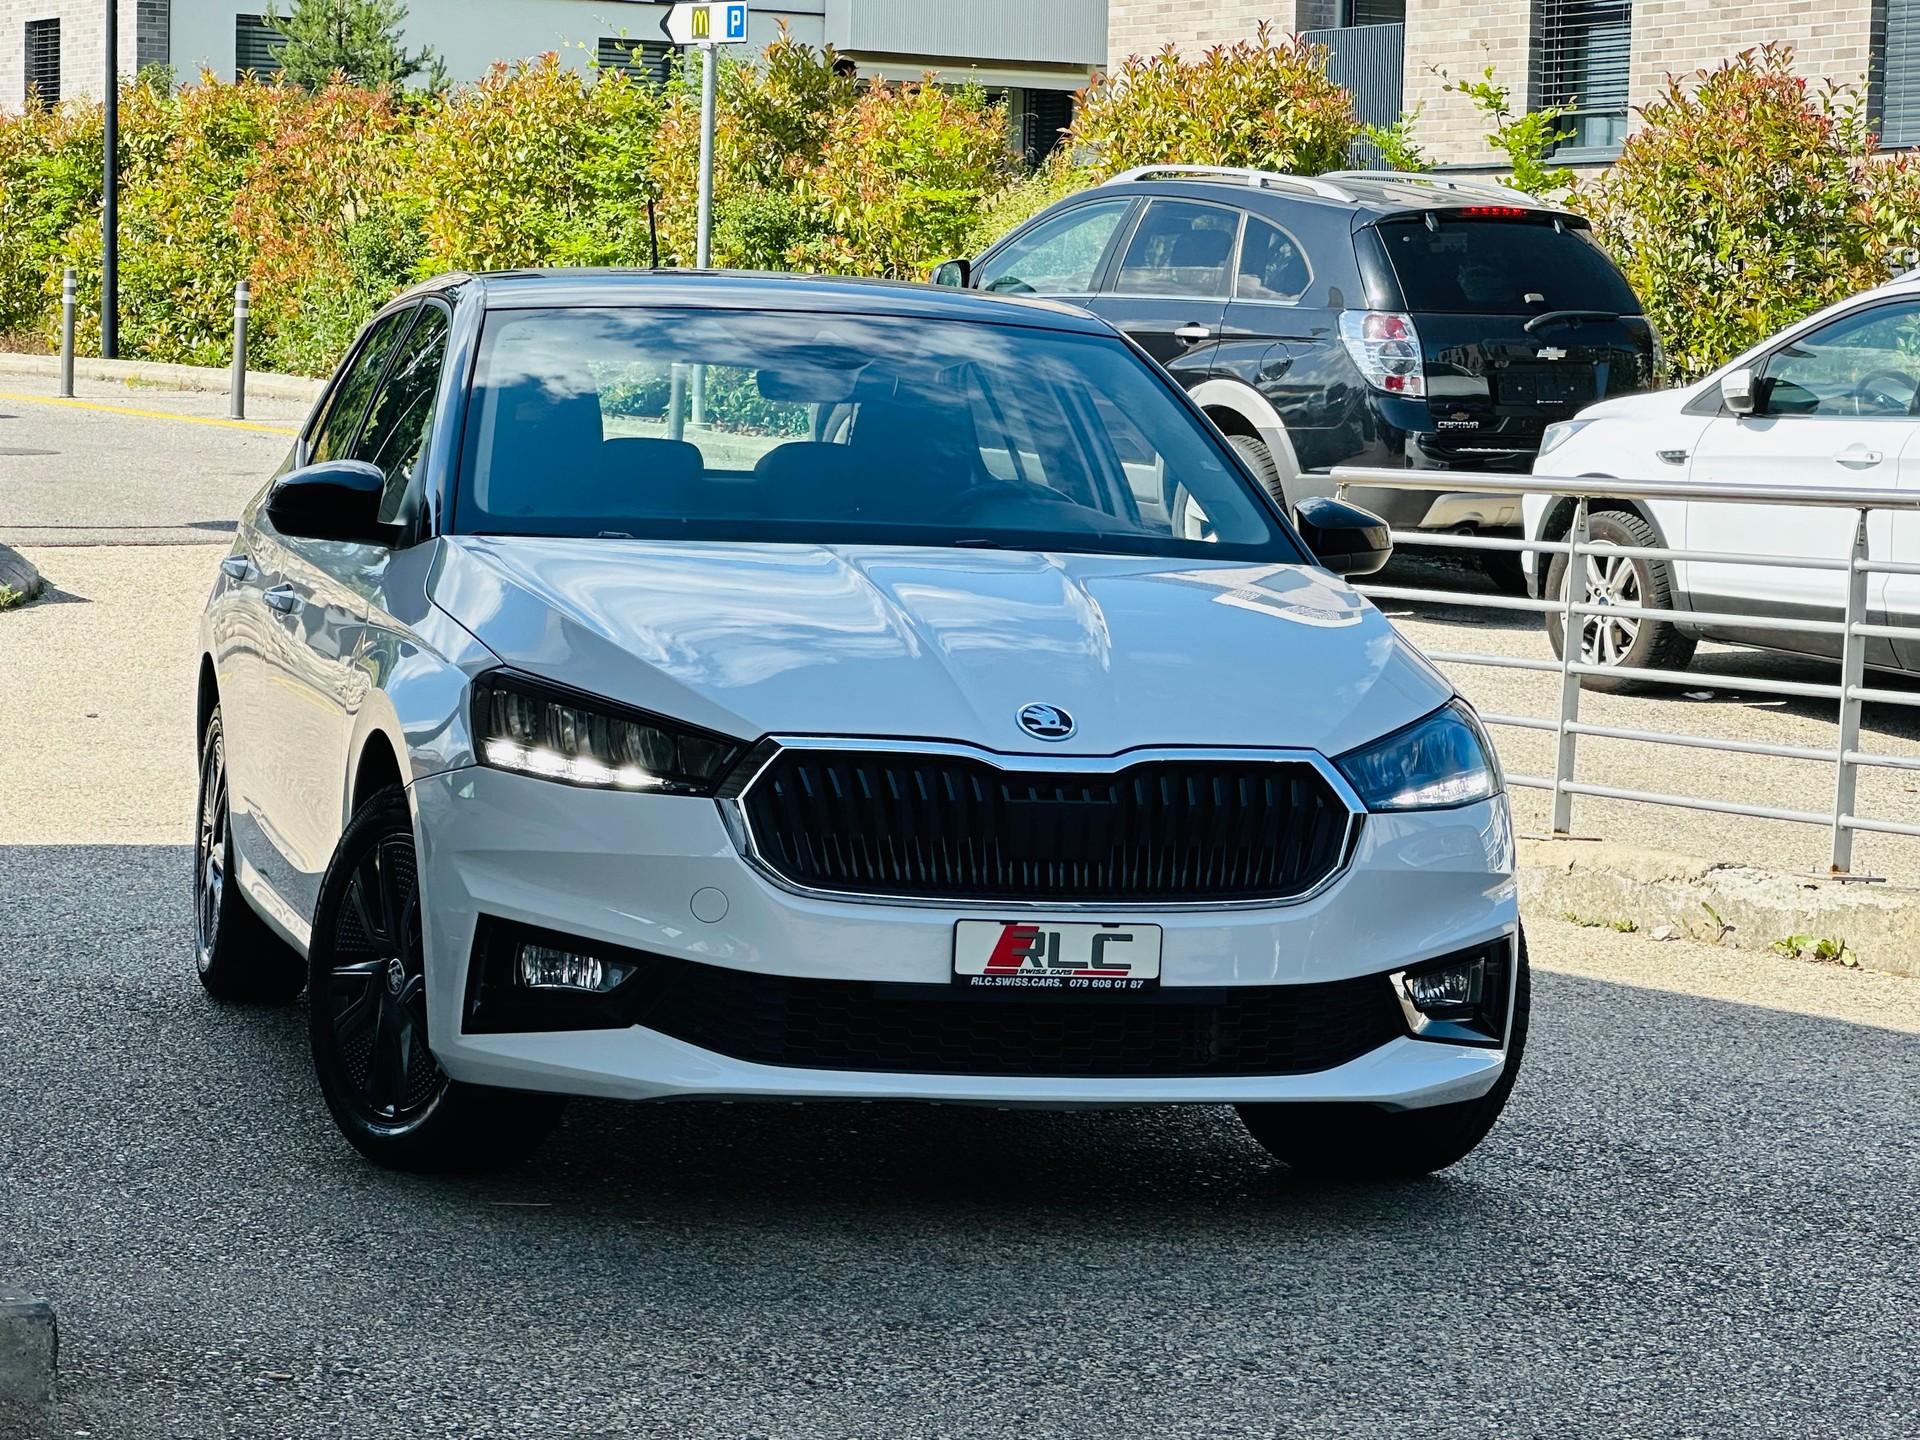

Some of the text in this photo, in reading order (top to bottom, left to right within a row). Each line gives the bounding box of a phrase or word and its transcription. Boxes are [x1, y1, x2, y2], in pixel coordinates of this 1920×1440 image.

[731, 10, 741, 35] P
[1437, 421, 1479, 429] CAPTIVA
[1012, 931, 1134, 970] RLC
[970, 976, 1144, 989] RLC.SWISS.CARS. 079 608 01 87
